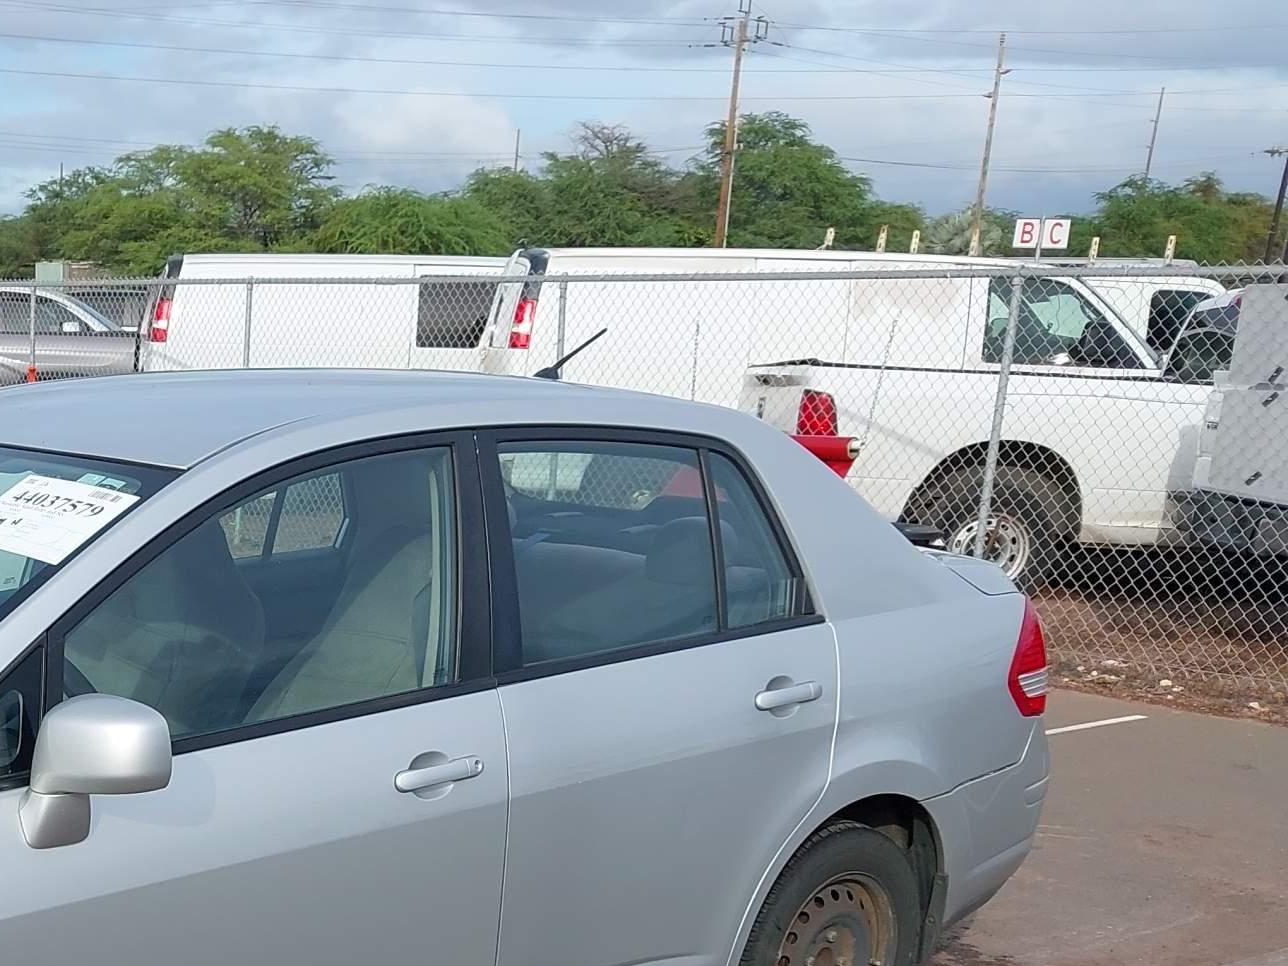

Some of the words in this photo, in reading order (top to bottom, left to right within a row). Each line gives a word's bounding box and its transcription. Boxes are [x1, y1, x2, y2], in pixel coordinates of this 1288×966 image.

[1020, 222, 1035, 244] B
[1049, 222, 1064, 245] C
[12, 490, 105, 517] 44037579
